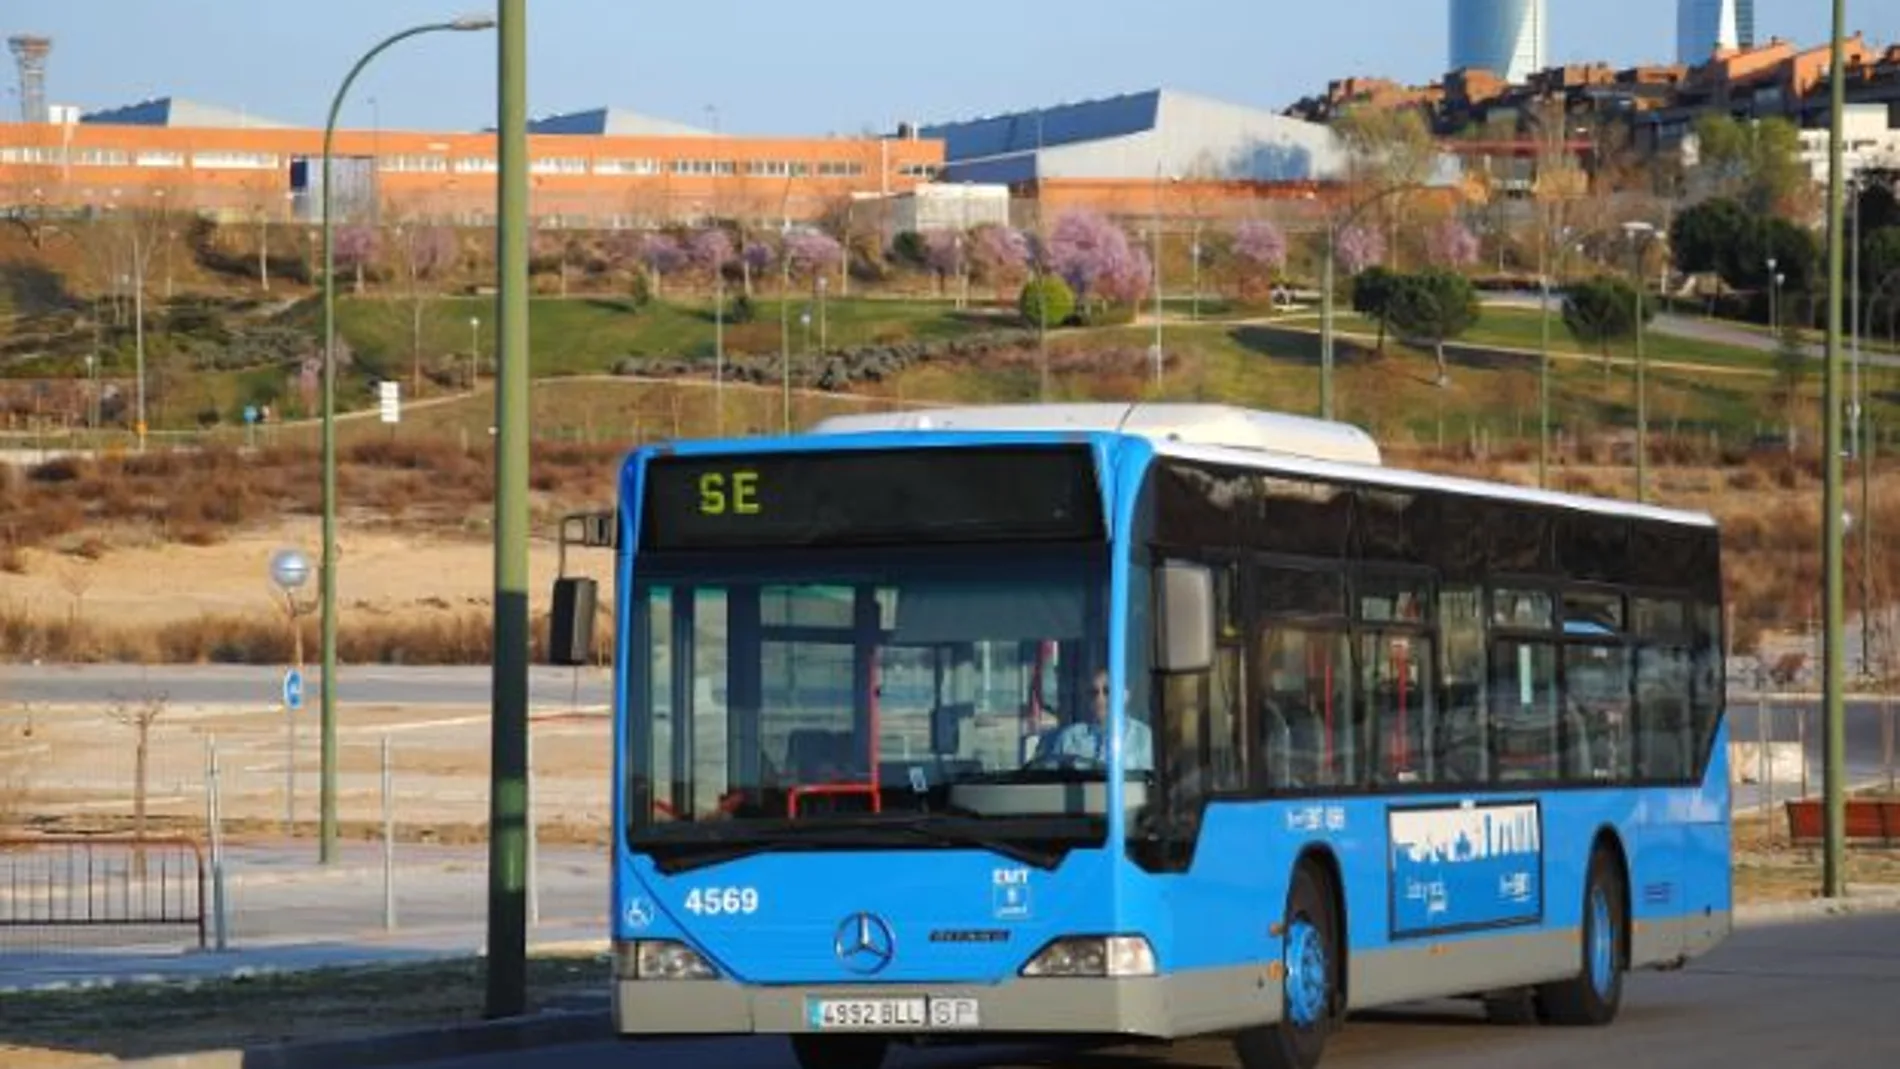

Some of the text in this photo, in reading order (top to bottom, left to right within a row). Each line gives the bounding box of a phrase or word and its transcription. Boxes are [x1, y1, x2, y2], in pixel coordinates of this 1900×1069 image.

[700, 472, 759, 514] SE
[684, 887, 759, 915] 4569
[824, 1003, 875, 1024] 4992
[934, 1001, 974, 1025] SP
